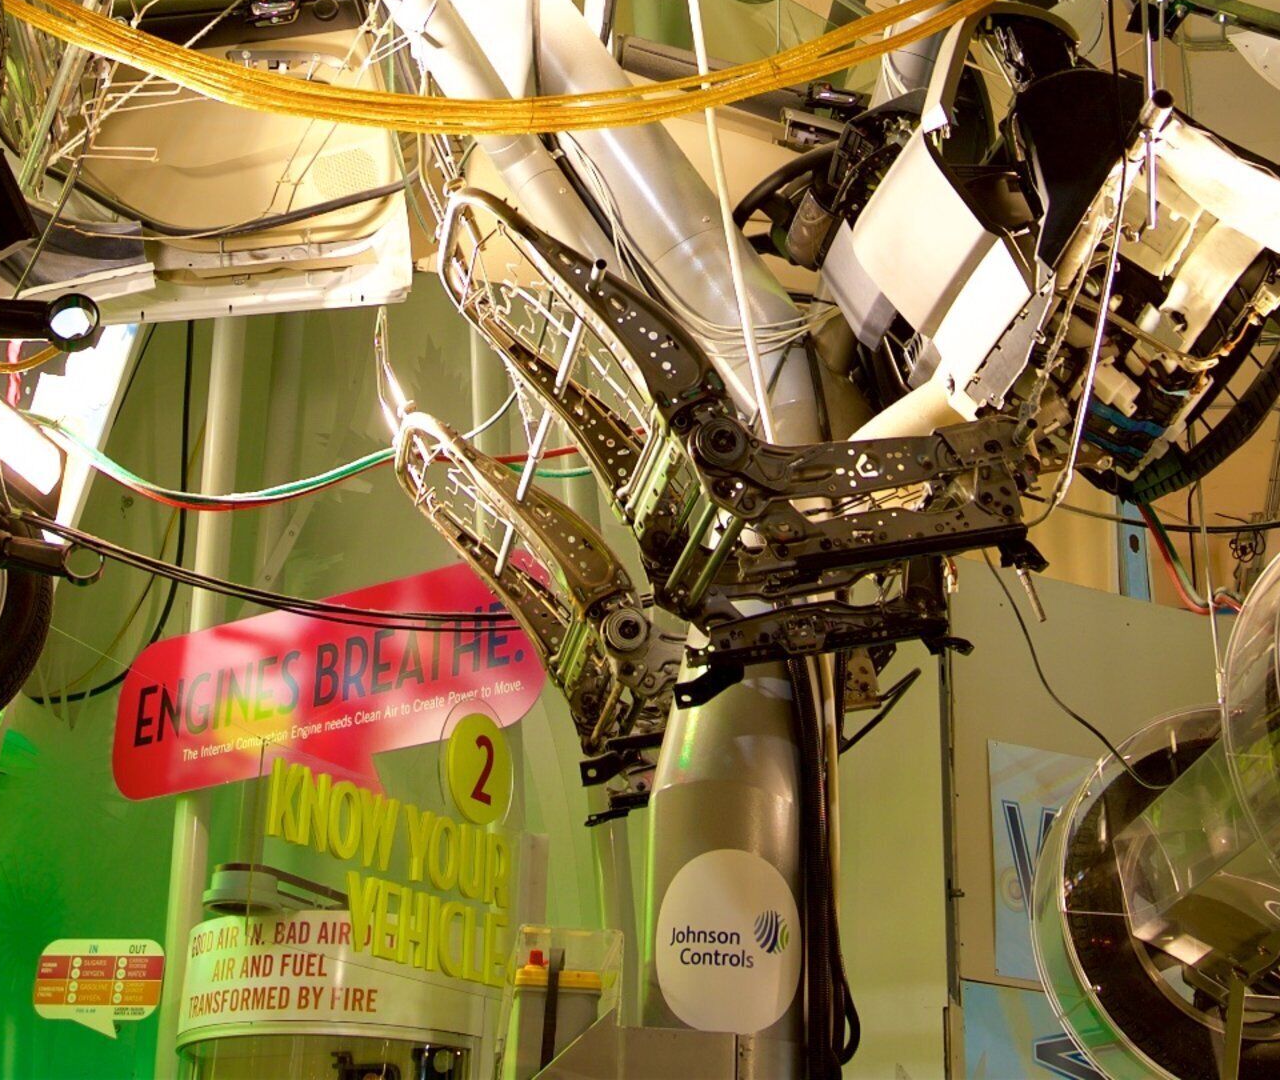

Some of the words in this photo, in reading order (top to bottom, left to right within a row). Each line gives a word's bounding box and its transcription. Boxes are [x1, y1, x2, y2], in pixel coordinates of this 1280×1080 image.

[134, 650, 301, 748] ENGINES
[313, 600, 525, 708] BREATHE.
[183, 748, 199, 762] The
[201, 741, 234, 758] Internal
[292, 722, 322, 740] Engine
[324, 714, 352, 732] needs
[354, 708, 381, 726] Clean
[384, 704, 399, 718] Air
[400, 702, 410, 716] to
[412, 695, 445, 713] Create
[448, 689, 478, 705] Power
[481, 685, 492, 698] to
[494, 679, 525, 695] Move.
[470, 734, 495, 806] 2
[268, 756, 401, 871] KNOW
[404, 803, 512, 909] YOUR
[217, 925, 240, 949] AIR
[274, 921, 311, 946] BAD
[317, 921, 352, 946] AIR
[347, 870, 510, 989] VEHICLE
[669, 925, 741, 946] Johnson
[128, 944, 147, 954] OUT
[680, 947, 755, 969] Controls
[212, 957, 236, 982] AIR
[239, 954, 274, 979] AND
[280, 953, 328, 978] FUEL
[188, 986, 290, 1019] TRANSFORMED
[297, 986, 325, 1011] BY
[330, 987, 379, 1013] FIRE
